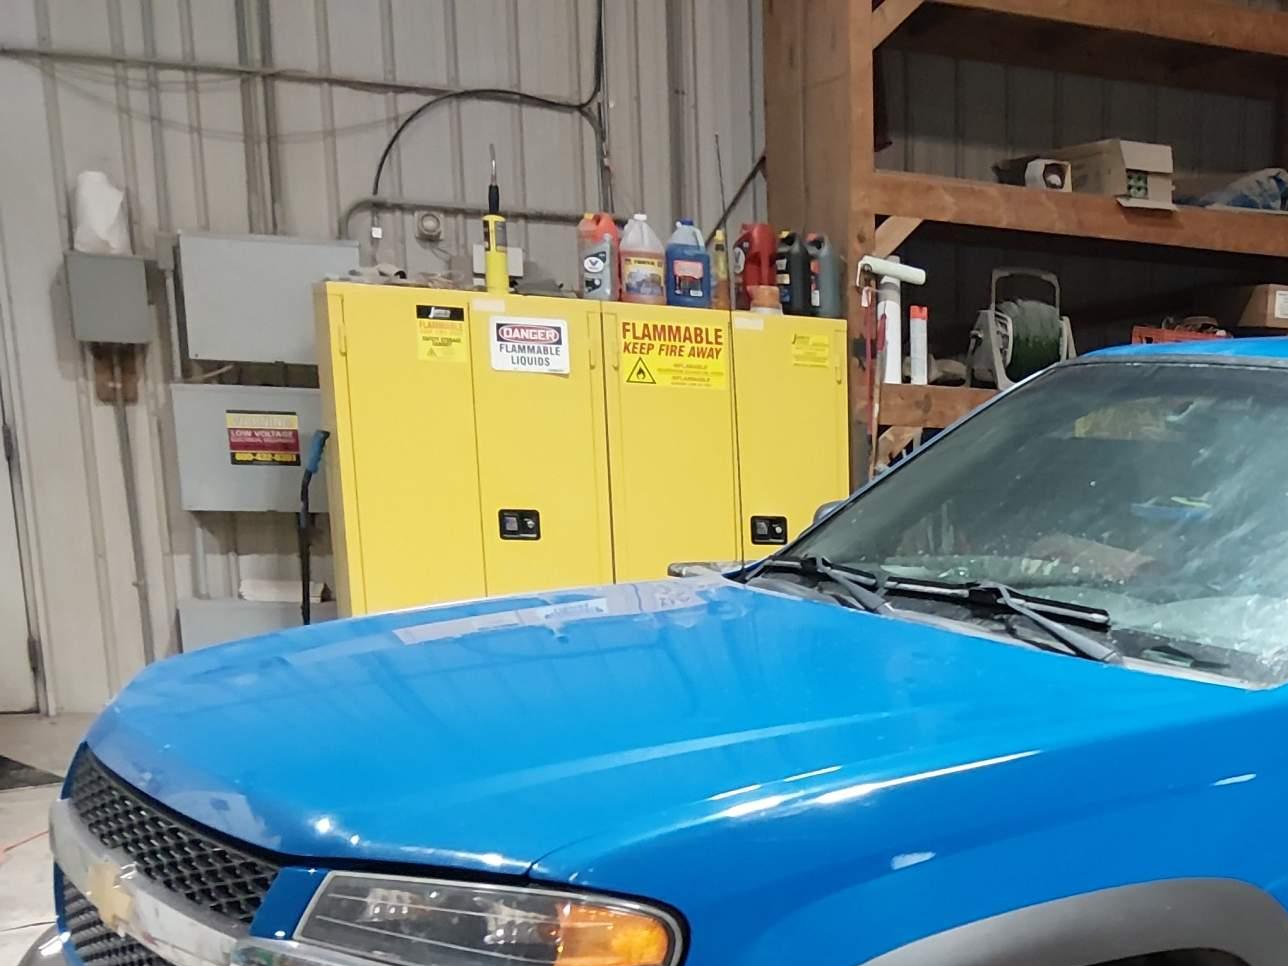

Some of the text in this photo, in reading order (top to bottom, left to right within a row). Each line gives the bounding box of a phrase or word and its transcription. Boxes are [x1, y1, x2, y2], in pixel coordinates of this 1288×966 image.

[503, 327, 555, 341] DANGER
[622, 322, 723, 345] FLAMMABLE
[499, 343, 561, 356] FLAMMABLE
[623, 341, 722, 360] KEEP FIRE AWAY
[511, 355, 550, 367] LIQUIDS
